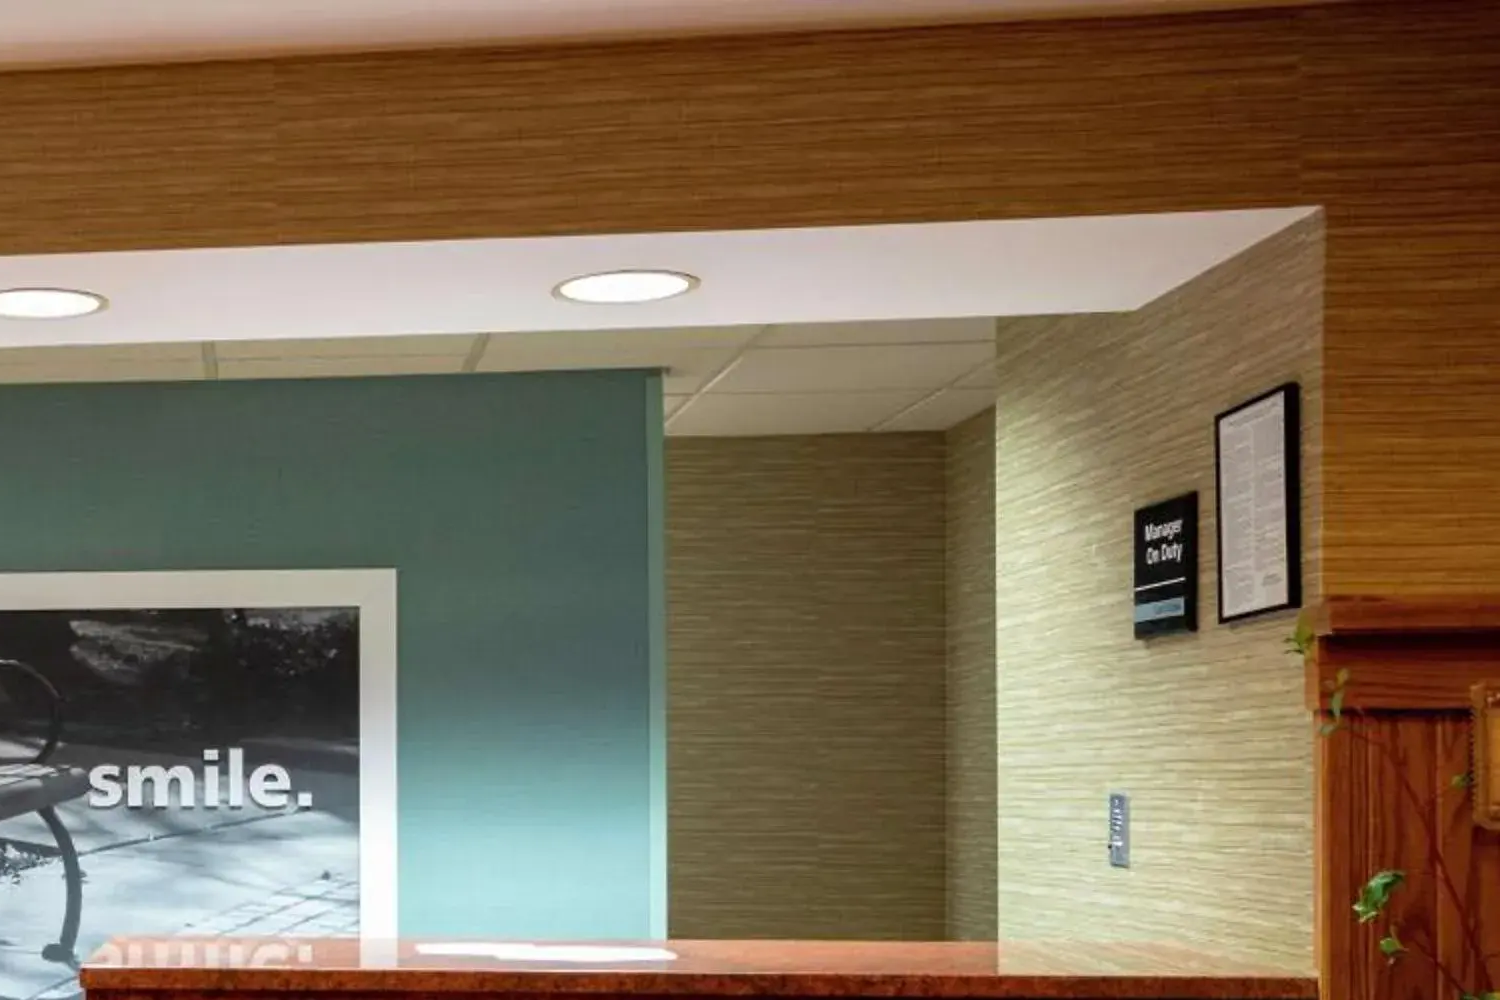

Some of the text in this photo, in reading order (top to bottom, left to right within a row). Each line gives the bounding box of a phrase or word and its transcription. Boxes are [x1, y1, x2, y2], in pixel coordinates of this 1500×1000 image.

[1144, 519, 1183, 542] Manager
[1146, 543, 1183, 565] On Duty
[89, 747, 313, 809] smile.
